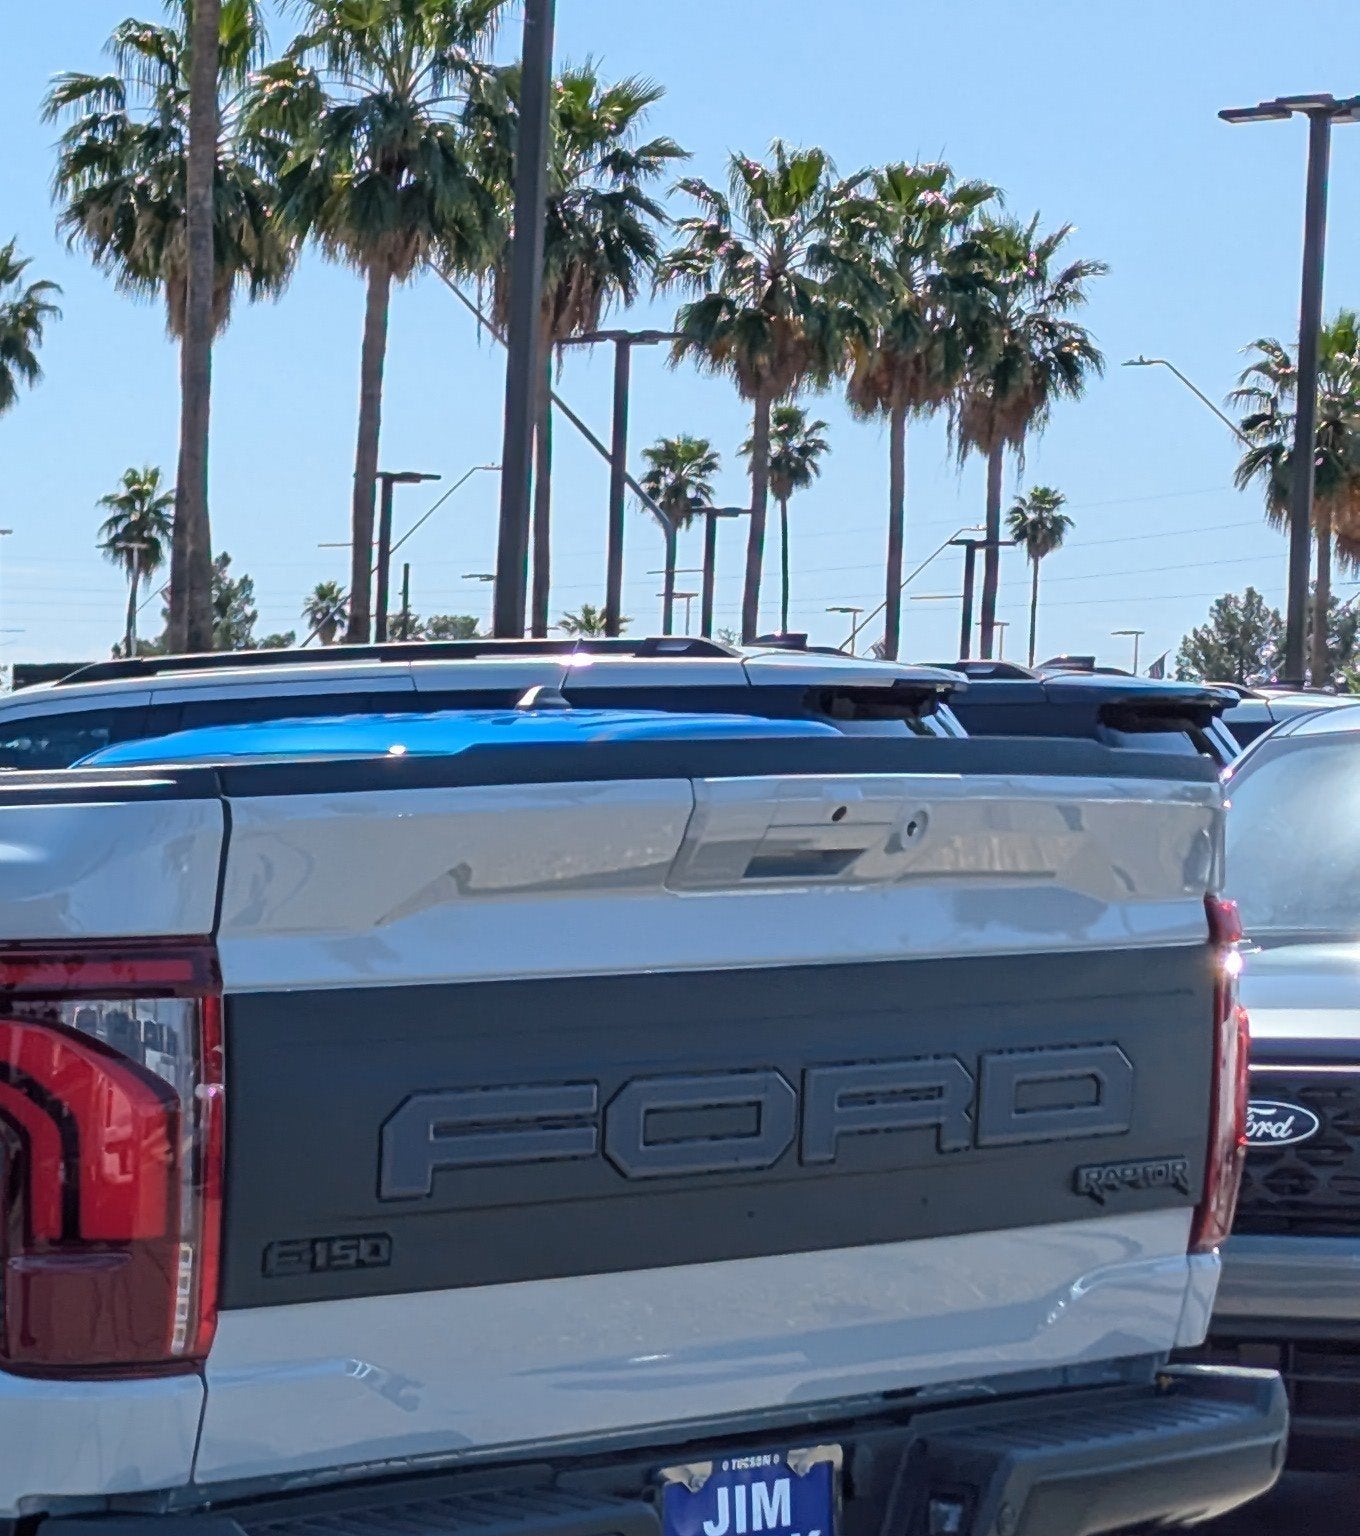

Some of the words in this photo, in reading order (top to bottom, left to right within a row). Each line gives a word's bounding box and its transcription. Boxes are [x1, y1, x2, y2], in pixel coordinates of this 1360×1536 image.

[376, 1040, 1134, 1202] FORD
[1072, 1156, 1190, 1204] RAPTOR
[732, 1454, 771, 1470] TUCSON
